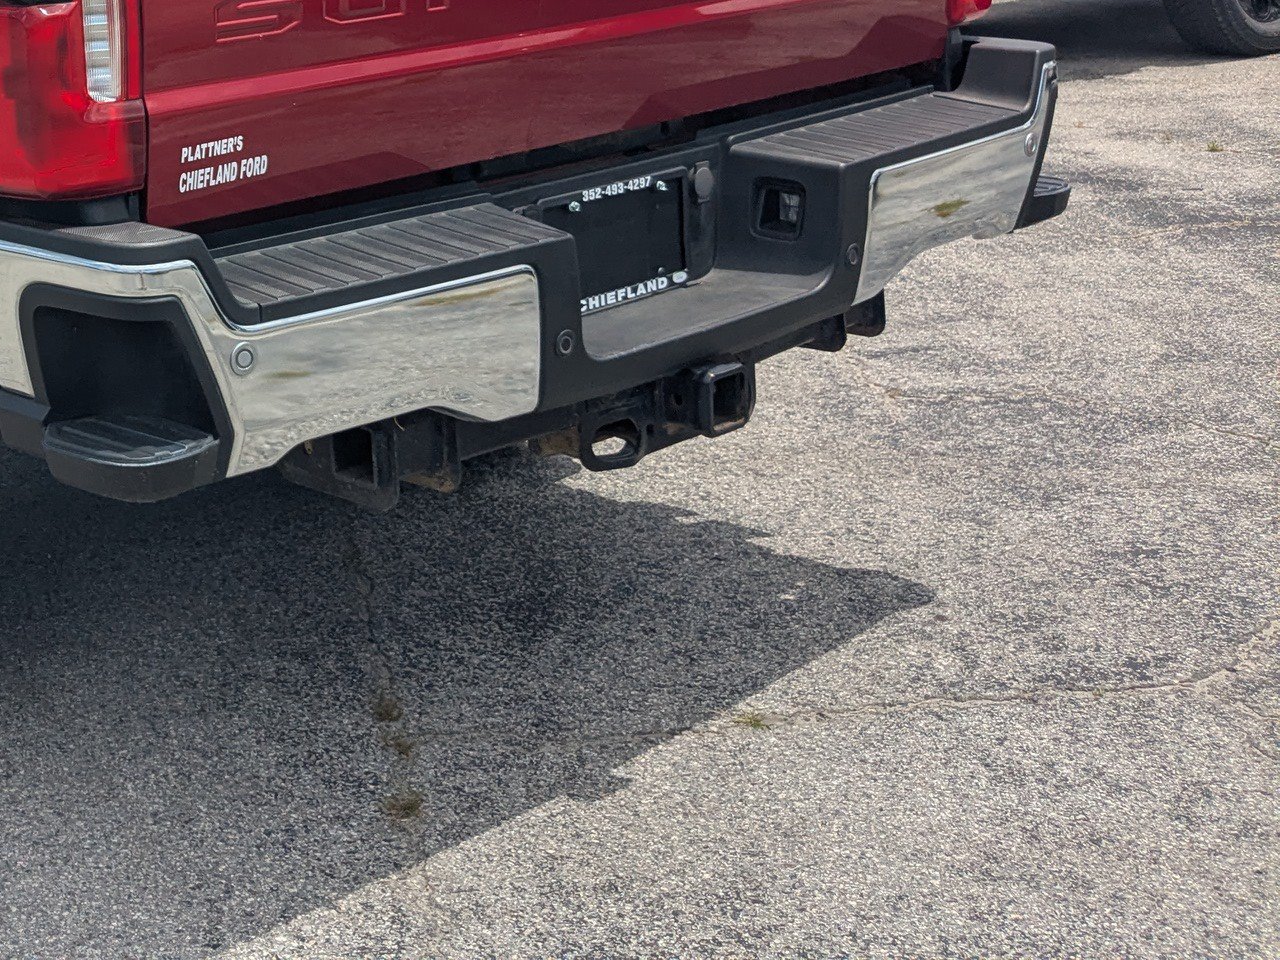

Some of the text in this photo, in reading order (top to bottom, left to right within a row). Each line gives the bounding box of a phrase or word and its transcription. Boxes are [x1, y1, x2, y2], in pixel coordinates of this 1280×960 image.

[180, 135, 244, 163] PLATTNER'S
[179, 154, 268, 193] CHIEFLAND FORD
[582, 176, 652, 202] 352-493-4297
